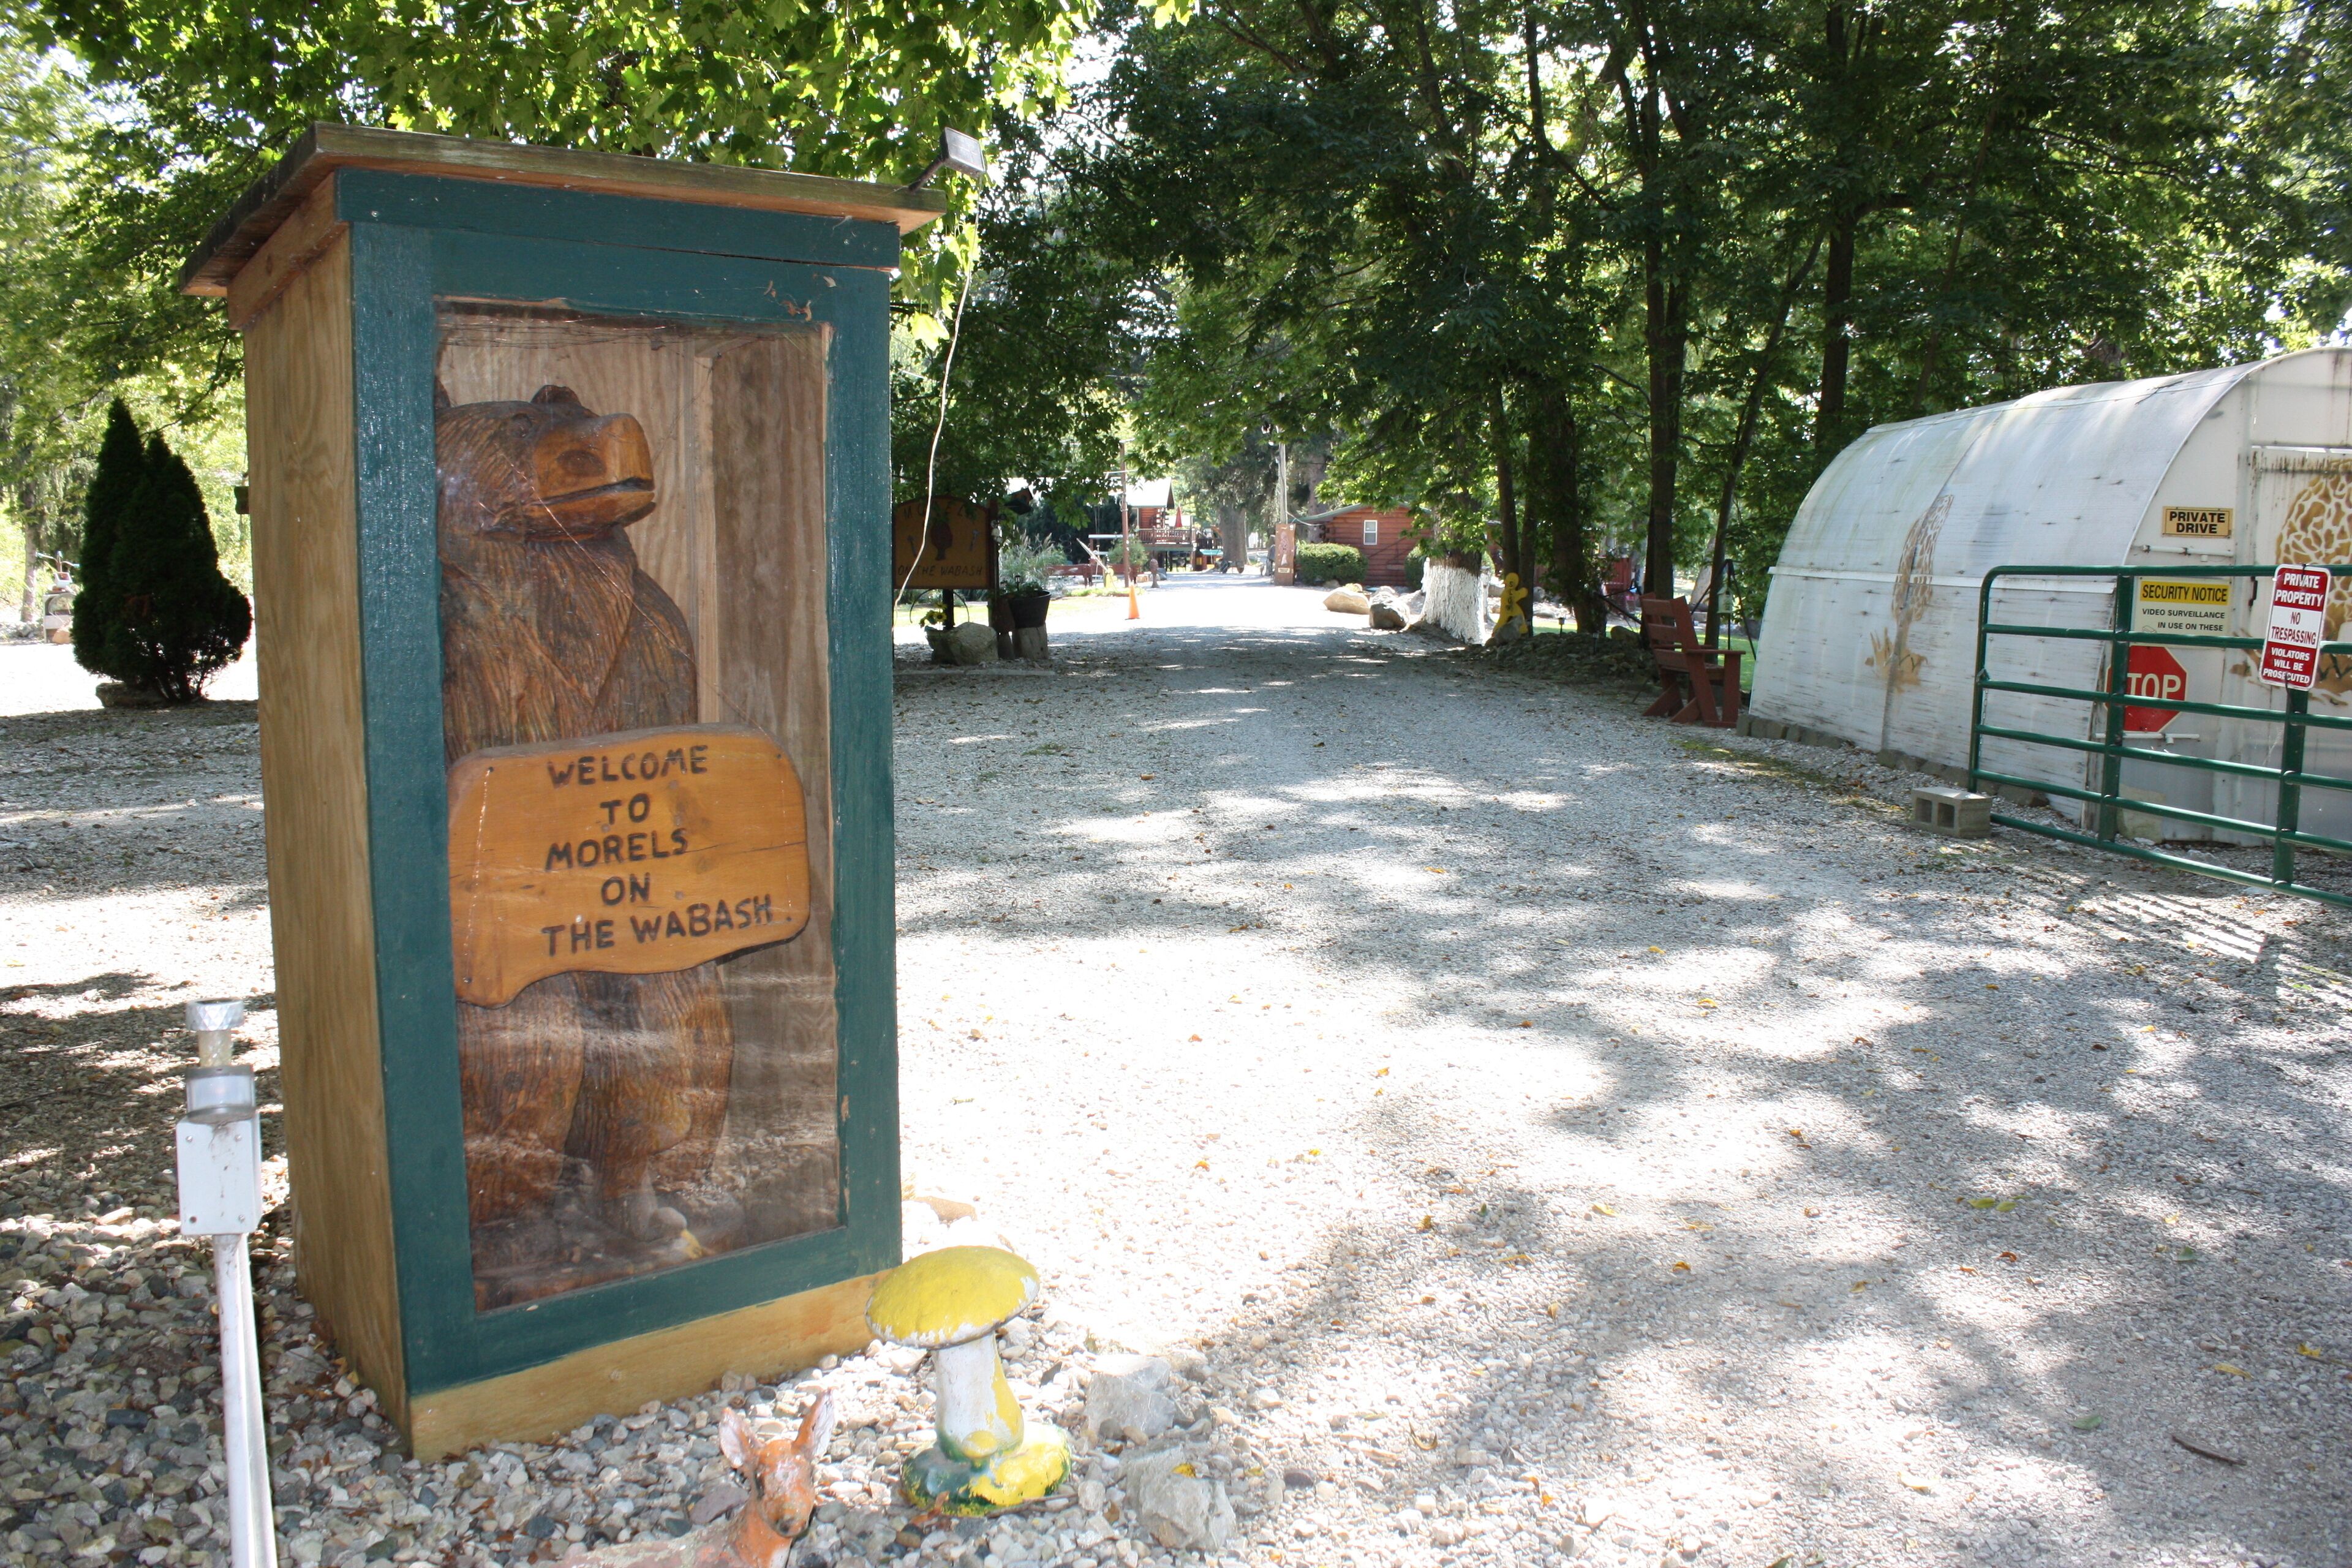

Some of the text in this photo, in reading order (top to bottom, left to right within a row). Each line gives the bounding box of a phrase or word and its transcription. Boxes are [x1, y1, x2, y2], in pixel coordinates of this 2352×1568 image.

[2169, 511, 2225, 523] PRIVATE
[2176, 523, 2217, 533] DRIVE
[941, 565, 982, 576] WABASH
[2283, 572, 2320, 589] PRIVATE
[2143, 584, 2227, 602] SECURITY NOTICE
[2275, 589, 2323, 607] PROPERTY
[2142, 608, 2225, 619] VIDEO SURVEILLANCE
[2290, 611, 2301, 625] NO
[2271, 626, 2316, 645] TRESPASSING
[2271, 647, 2310, 662] VIOLATORS
[2274, 658, 2304, 671] WILL BE
[2263, 668, 2310, 684] PROSECUTED
[2127, 673, 2182, 699] TOP
[546, 745, 709, 788] WELCOME
[600, 793, 650, 825] TO
[545, 827, 688, 872] MORELS
[600, 872, 650, 907] ON
[541, 894, 774, 956] THE WABASH
